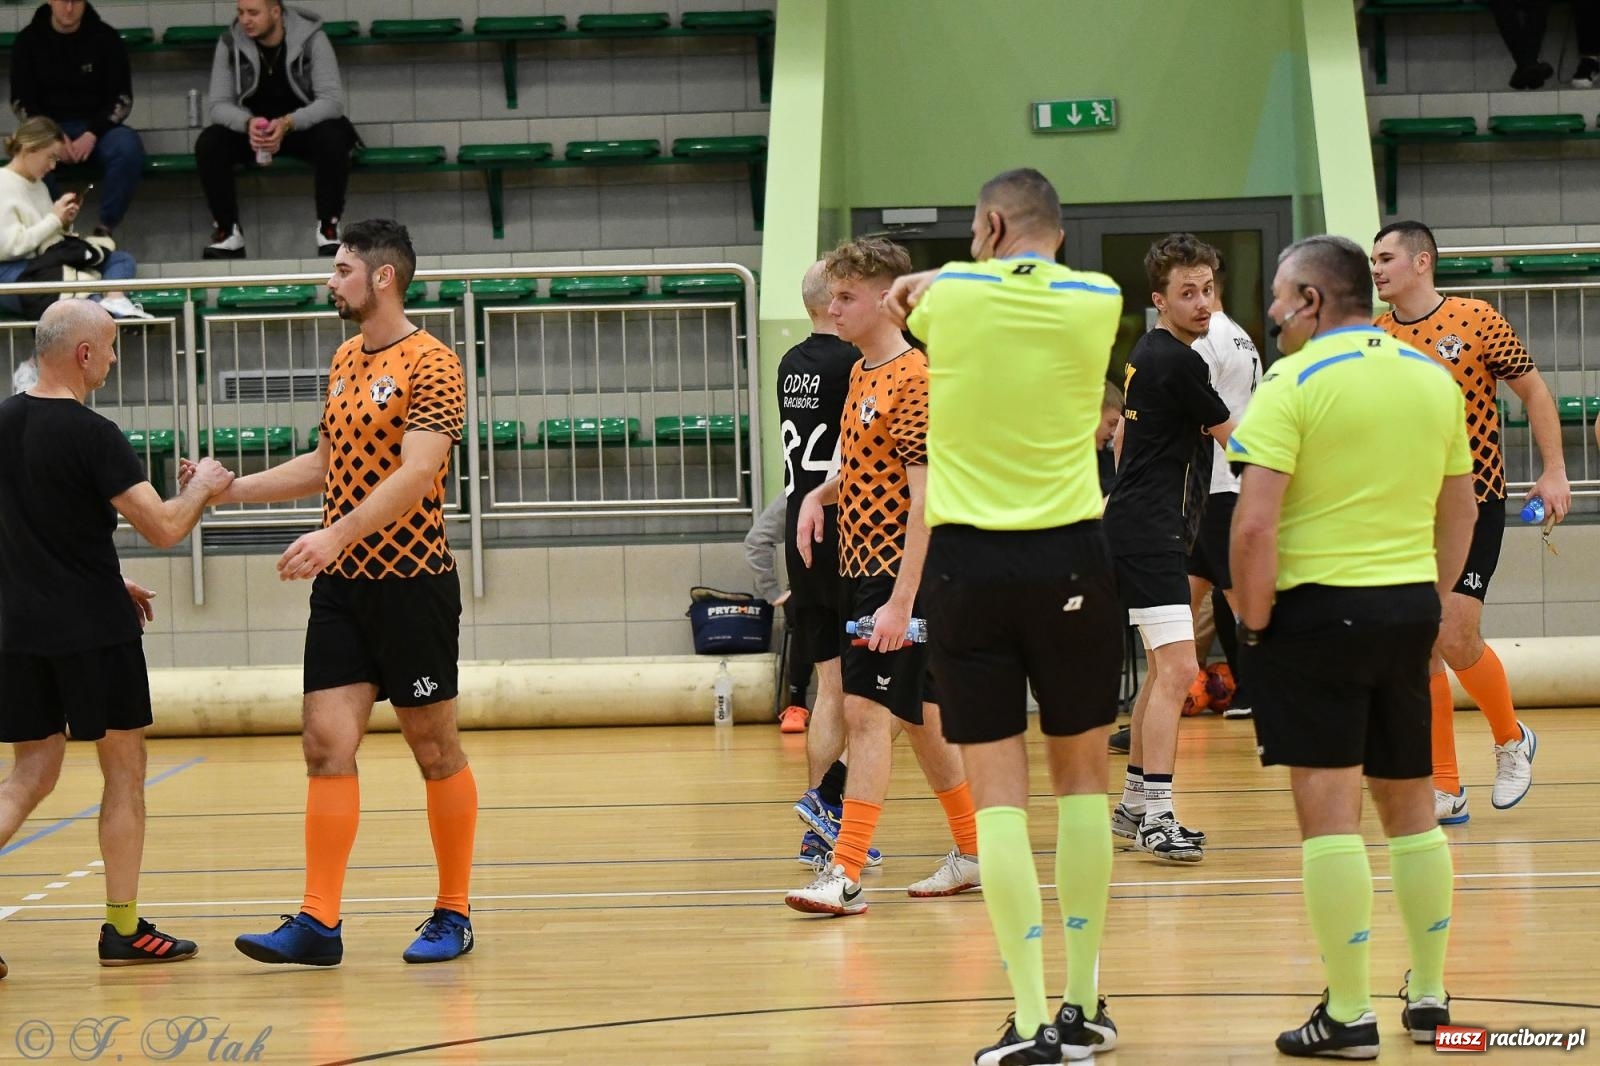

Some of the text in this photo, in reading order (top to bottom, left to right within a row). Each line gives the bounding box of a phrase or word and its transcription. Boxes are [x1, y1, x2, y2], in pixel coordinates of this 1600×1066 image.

[783, 374, 820, 394] ODRA
[783, 394, 820, 409] RACIBÓRZ
[781, 419, 841, 498] 84
[707, 605, 762, 617] PRYZMAT
